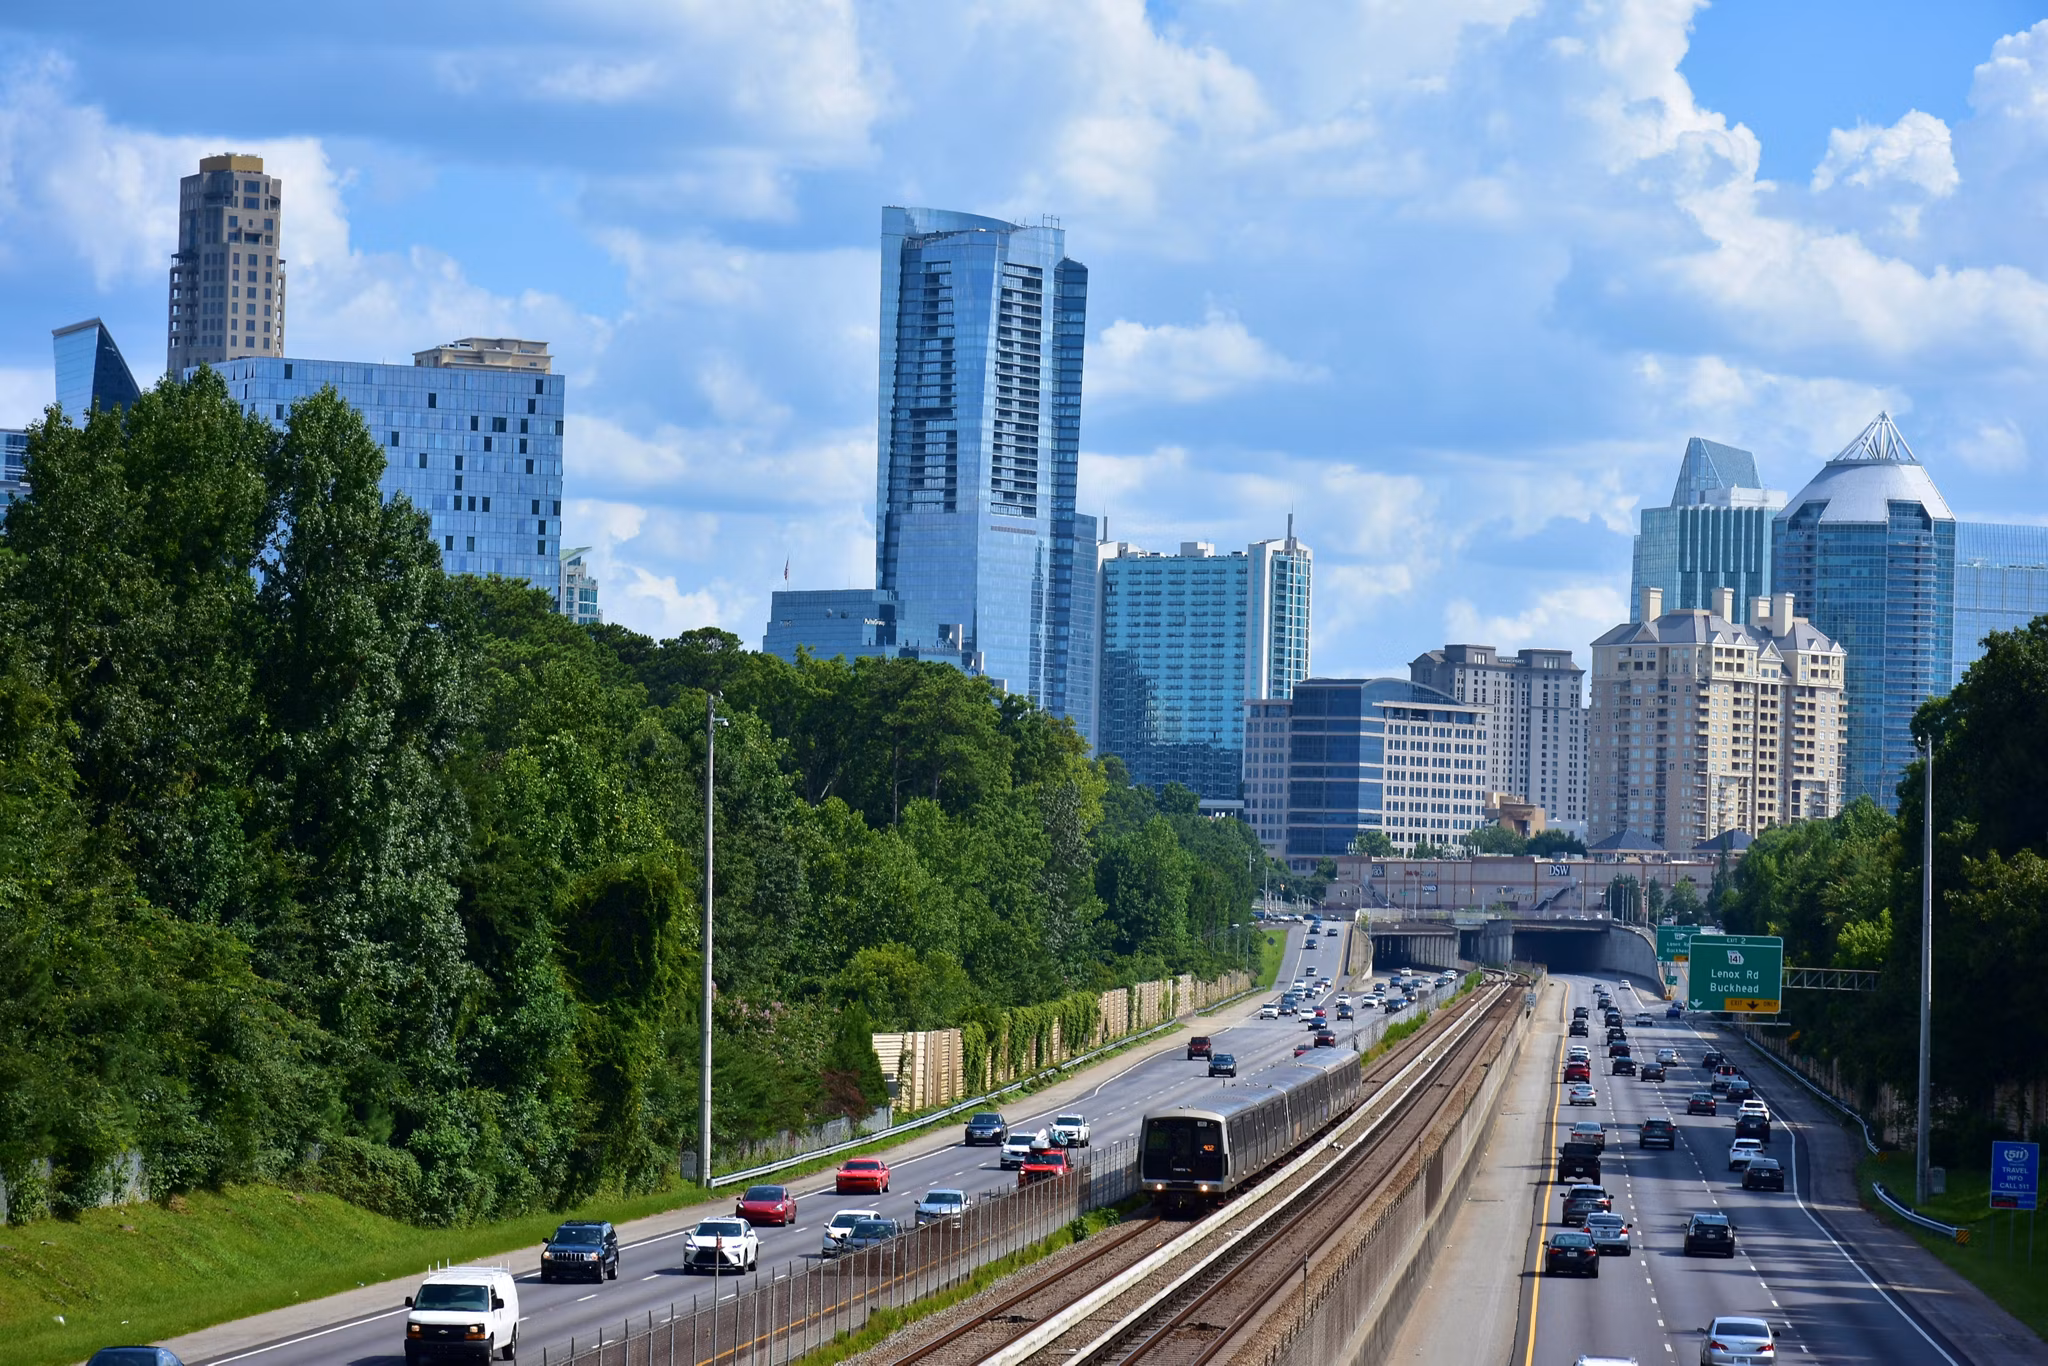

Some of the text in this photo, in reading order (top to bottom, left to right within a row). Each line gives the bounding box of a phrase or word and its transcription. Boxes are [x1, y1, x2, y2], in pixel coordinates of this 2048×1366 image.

[1549, 865, 1569, 876] DSW
[1740, 937, 1746, 945] 2
[1730, 955, 1741, 964] 141
[1711, 969, 1759, 980] Lenox Rd
[1710, 982, 1759, 993] Buckhead
[2008, 1150, 2023, 1159] 511
